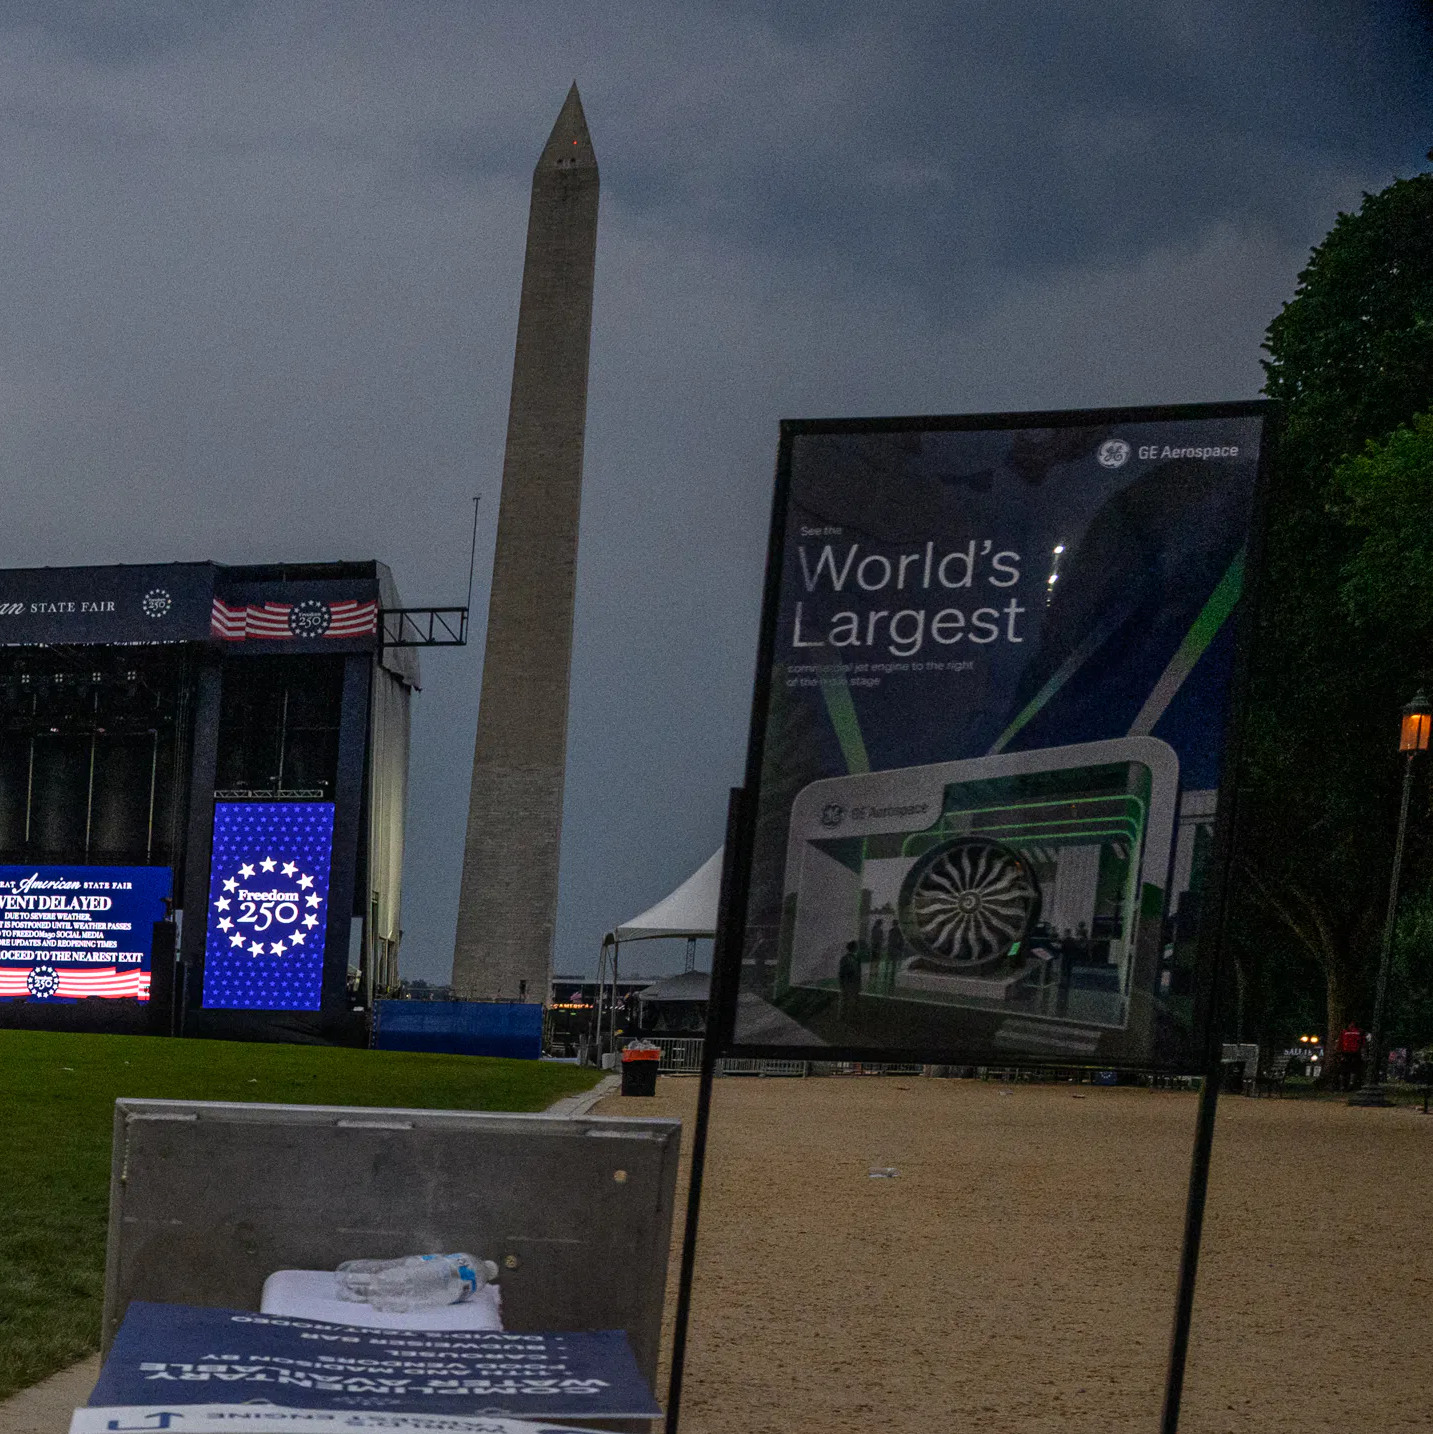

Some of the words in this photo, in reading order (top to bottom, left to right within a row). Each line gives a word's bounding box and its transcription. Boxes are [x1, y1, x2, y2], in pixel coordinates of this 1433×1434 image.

[1138, 446, 1158, 459] GE
[1160, 446, 1239, 460] Aerospace
[801, 526, 821, 536] See
[798, 539, 1021, 593] World's
[30, 602, 76, 614] STATE
[80, 601, 116, 612] FAIR
[148, 602, 166, 611] 250
[298, 616, 321, 628] 250
[792, 597, 1025, 657] Largest
[854, 663, 869, 674] jet
[871, 663, 909, 674] engine
[912, 663, 923, 671] to
[946, 660, 974, 672] right
[850, 678, 881, 688] stage
[11, 873, 81, 894] American
[238, 889, 299, 901] Freedom
[38, 895, 112, 911] DELAYED
[4, 912, 20, 920] DUE
[20, 912, 30, 920] TO
[30, 912, 56, 920] SEVERE
[237, 901, 299, 931] 250
[11, 921, 51, 929] POSTPONED
[73, 922, 106, 930] WEATHER
[108, 922, 131, 930] PASSES
[82, 931, 104, 939] MEDIA
[43, 939, 56, 947] AND
[35, 951, 49, 960] TO
[50, 951, 71, 961] THE
[72, 952, 118, 962] NEAREST
[118, 952, 144, 962] EXIT
[34, 979, 52, 989] 250
[301, 1333, 361, 1343] BAR
[369, 1338, 547, 1350] BUDWEISER
[383, 1349, 548, 1360] CAROUSEL
[250, 1355, 394, 1374] MADISON
[318, 1356, 468, 1368] VENDORS
[139, 1363, 413, 1387] AVAILABLE
[404, 1368, 472, 1376] AND
[144, 1371, 600, 1394] COMPLIMENTARY
[427, 1379, 611, 1387] WATER
